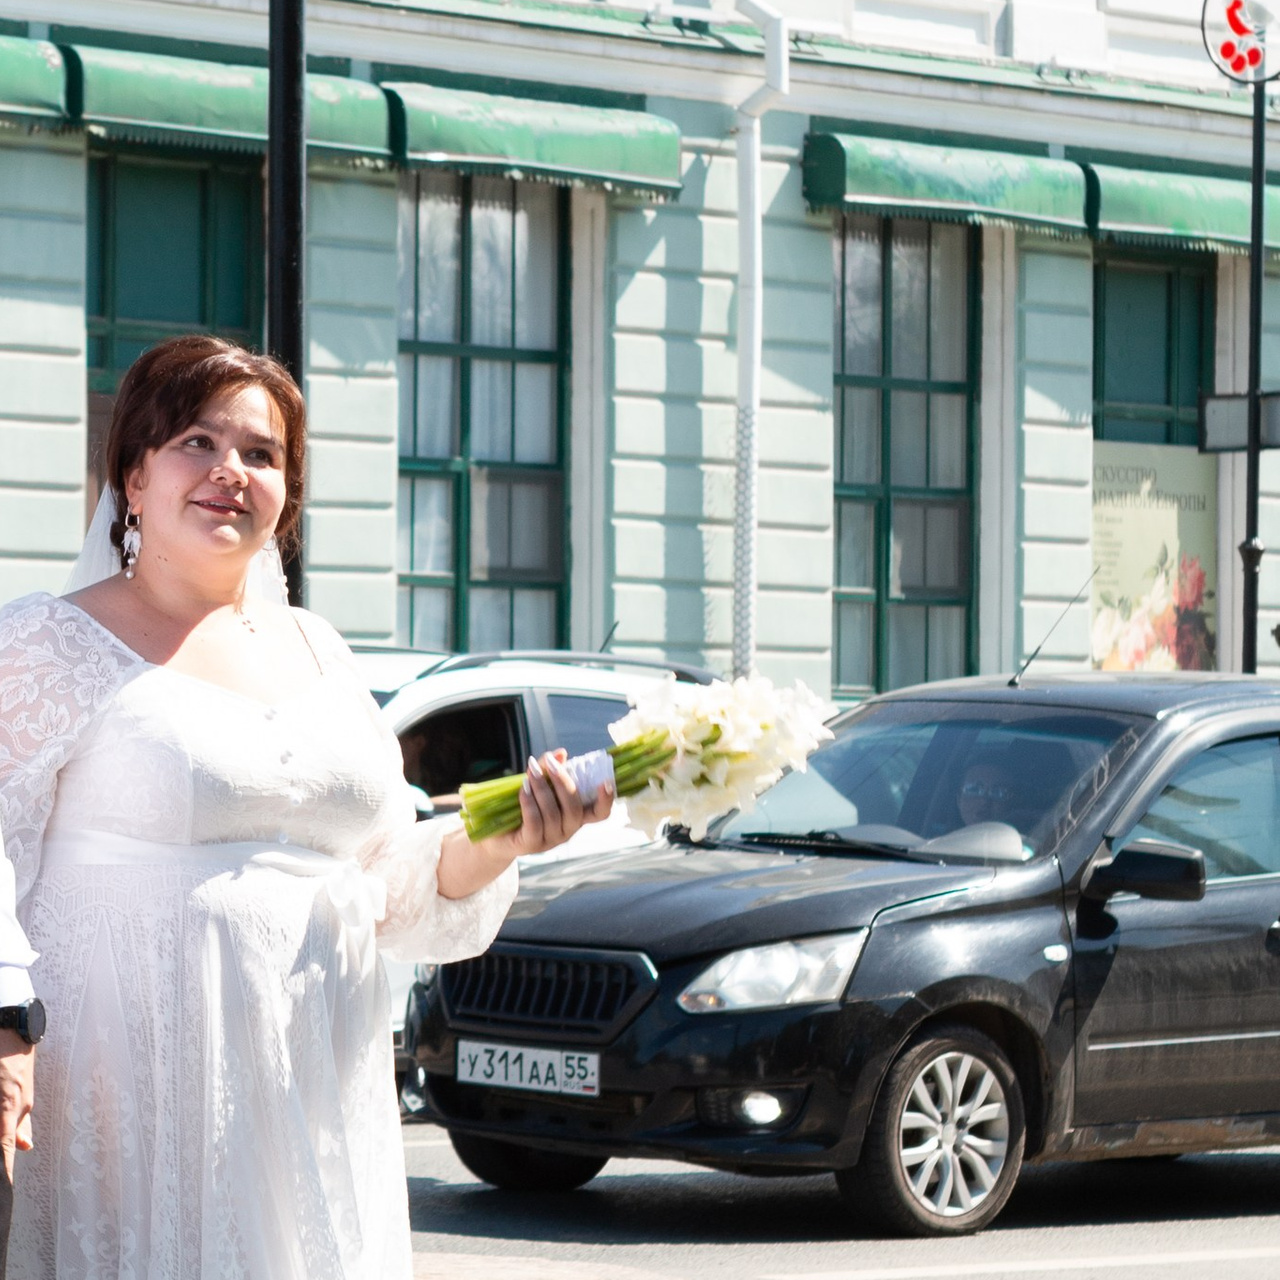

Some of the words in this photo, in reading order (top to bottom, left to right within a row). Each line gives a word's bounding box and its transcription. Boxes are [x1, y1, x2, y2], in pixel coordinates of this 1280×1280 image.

[1093, 463, 1158, 486] СКУССТВО
[565, 1055, 589, 1080] 55
[563, 1081, 582, 1091] RUS
